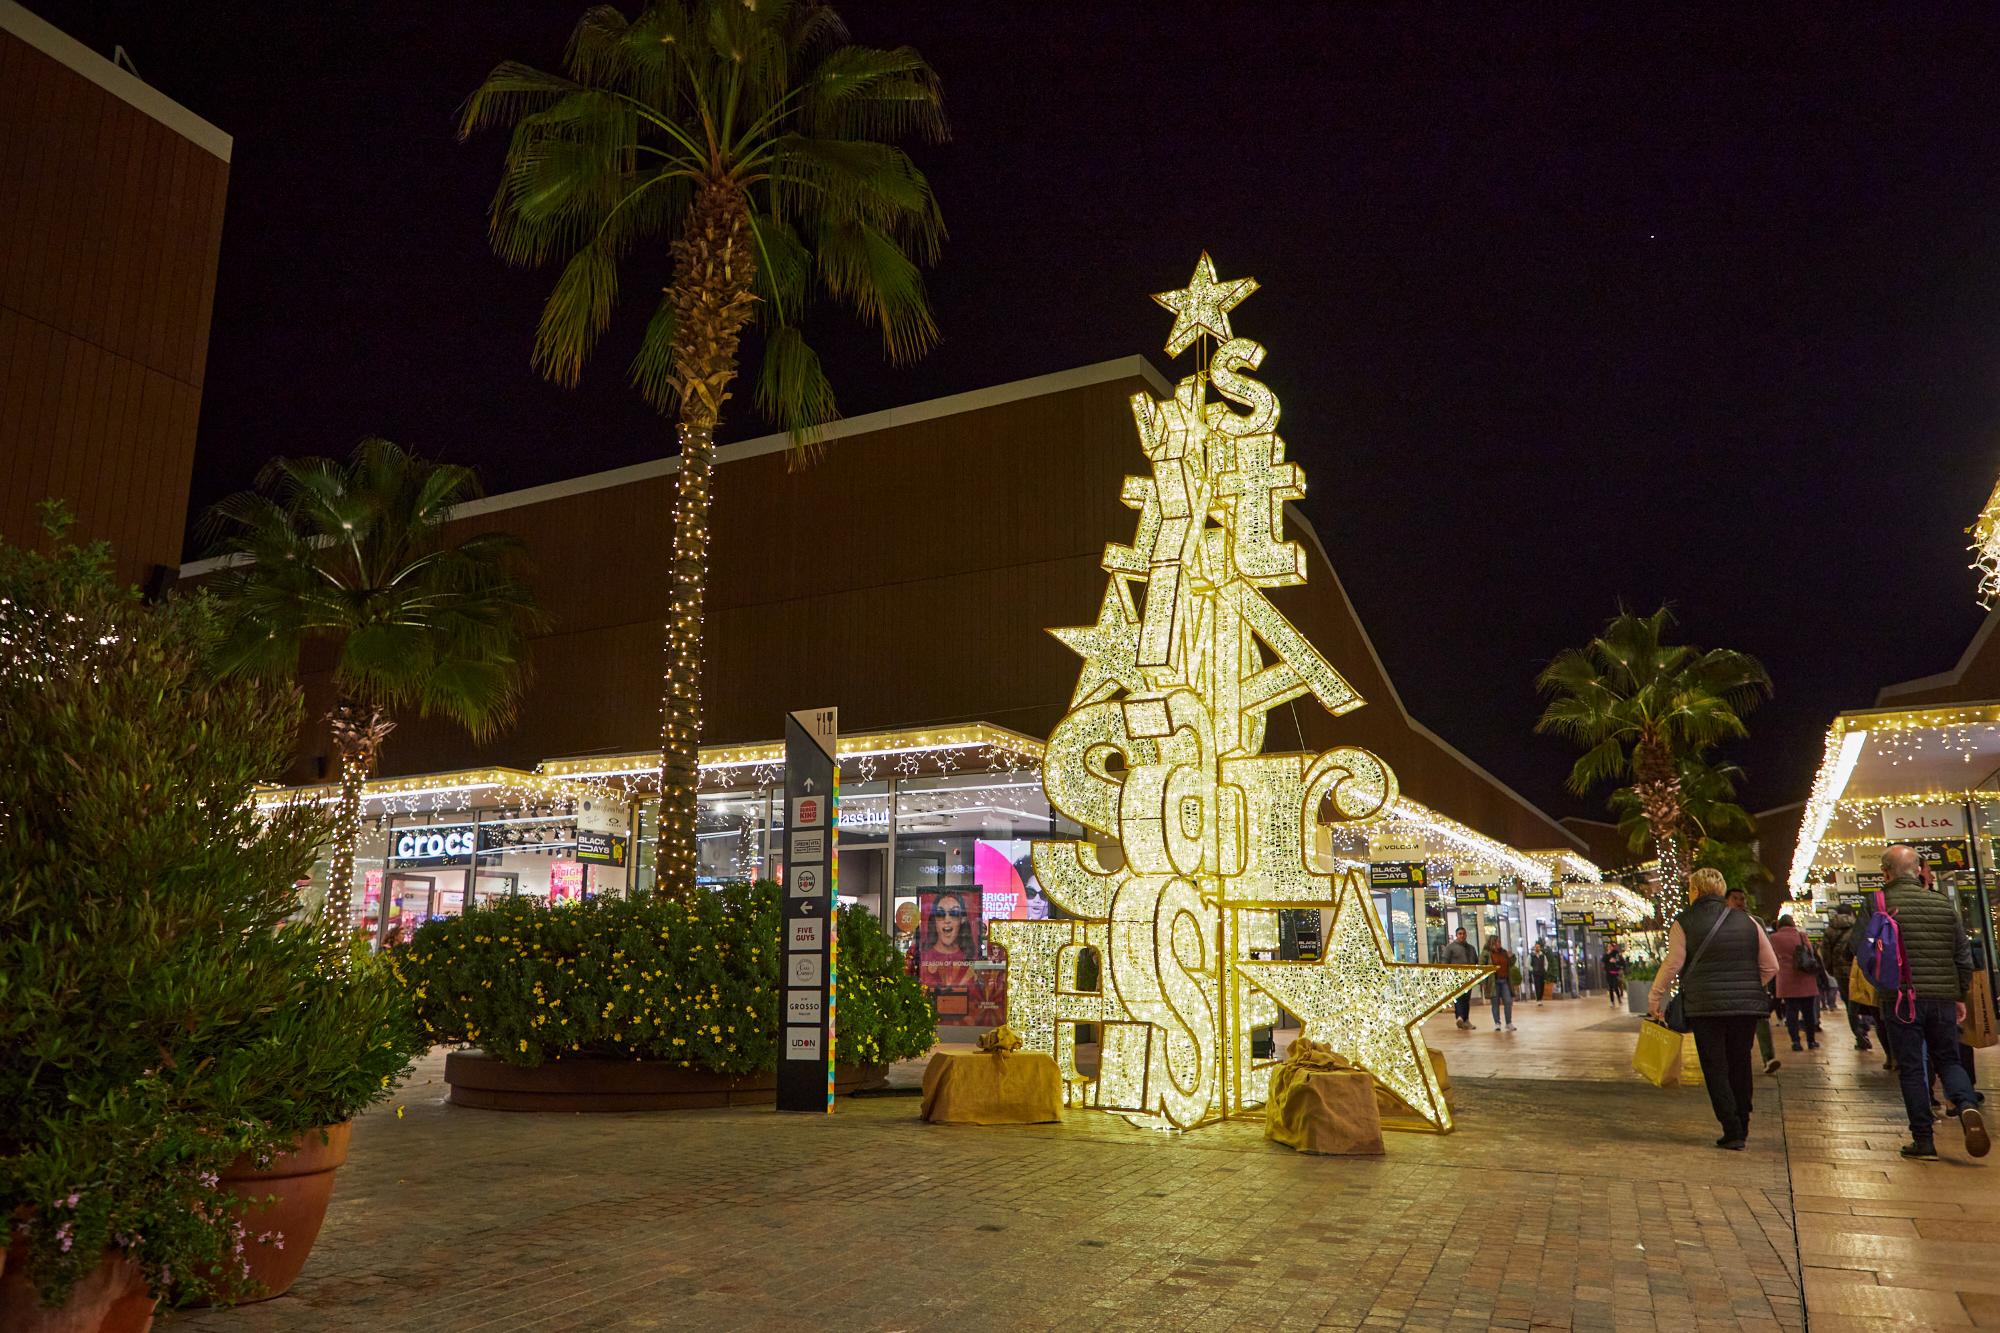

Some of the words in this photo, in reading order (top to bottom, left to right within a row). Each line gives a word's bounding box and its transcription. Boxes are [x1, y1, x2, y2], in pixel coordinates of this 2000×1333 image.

[398, 831, 475, 857] crocs
[578, 836, 606, 846] BLACK
[578, 844, 610, 854] DAYS
[1372, 872, 1408, 880] DAYS
[792, 1039, 816, 1047] UDON
